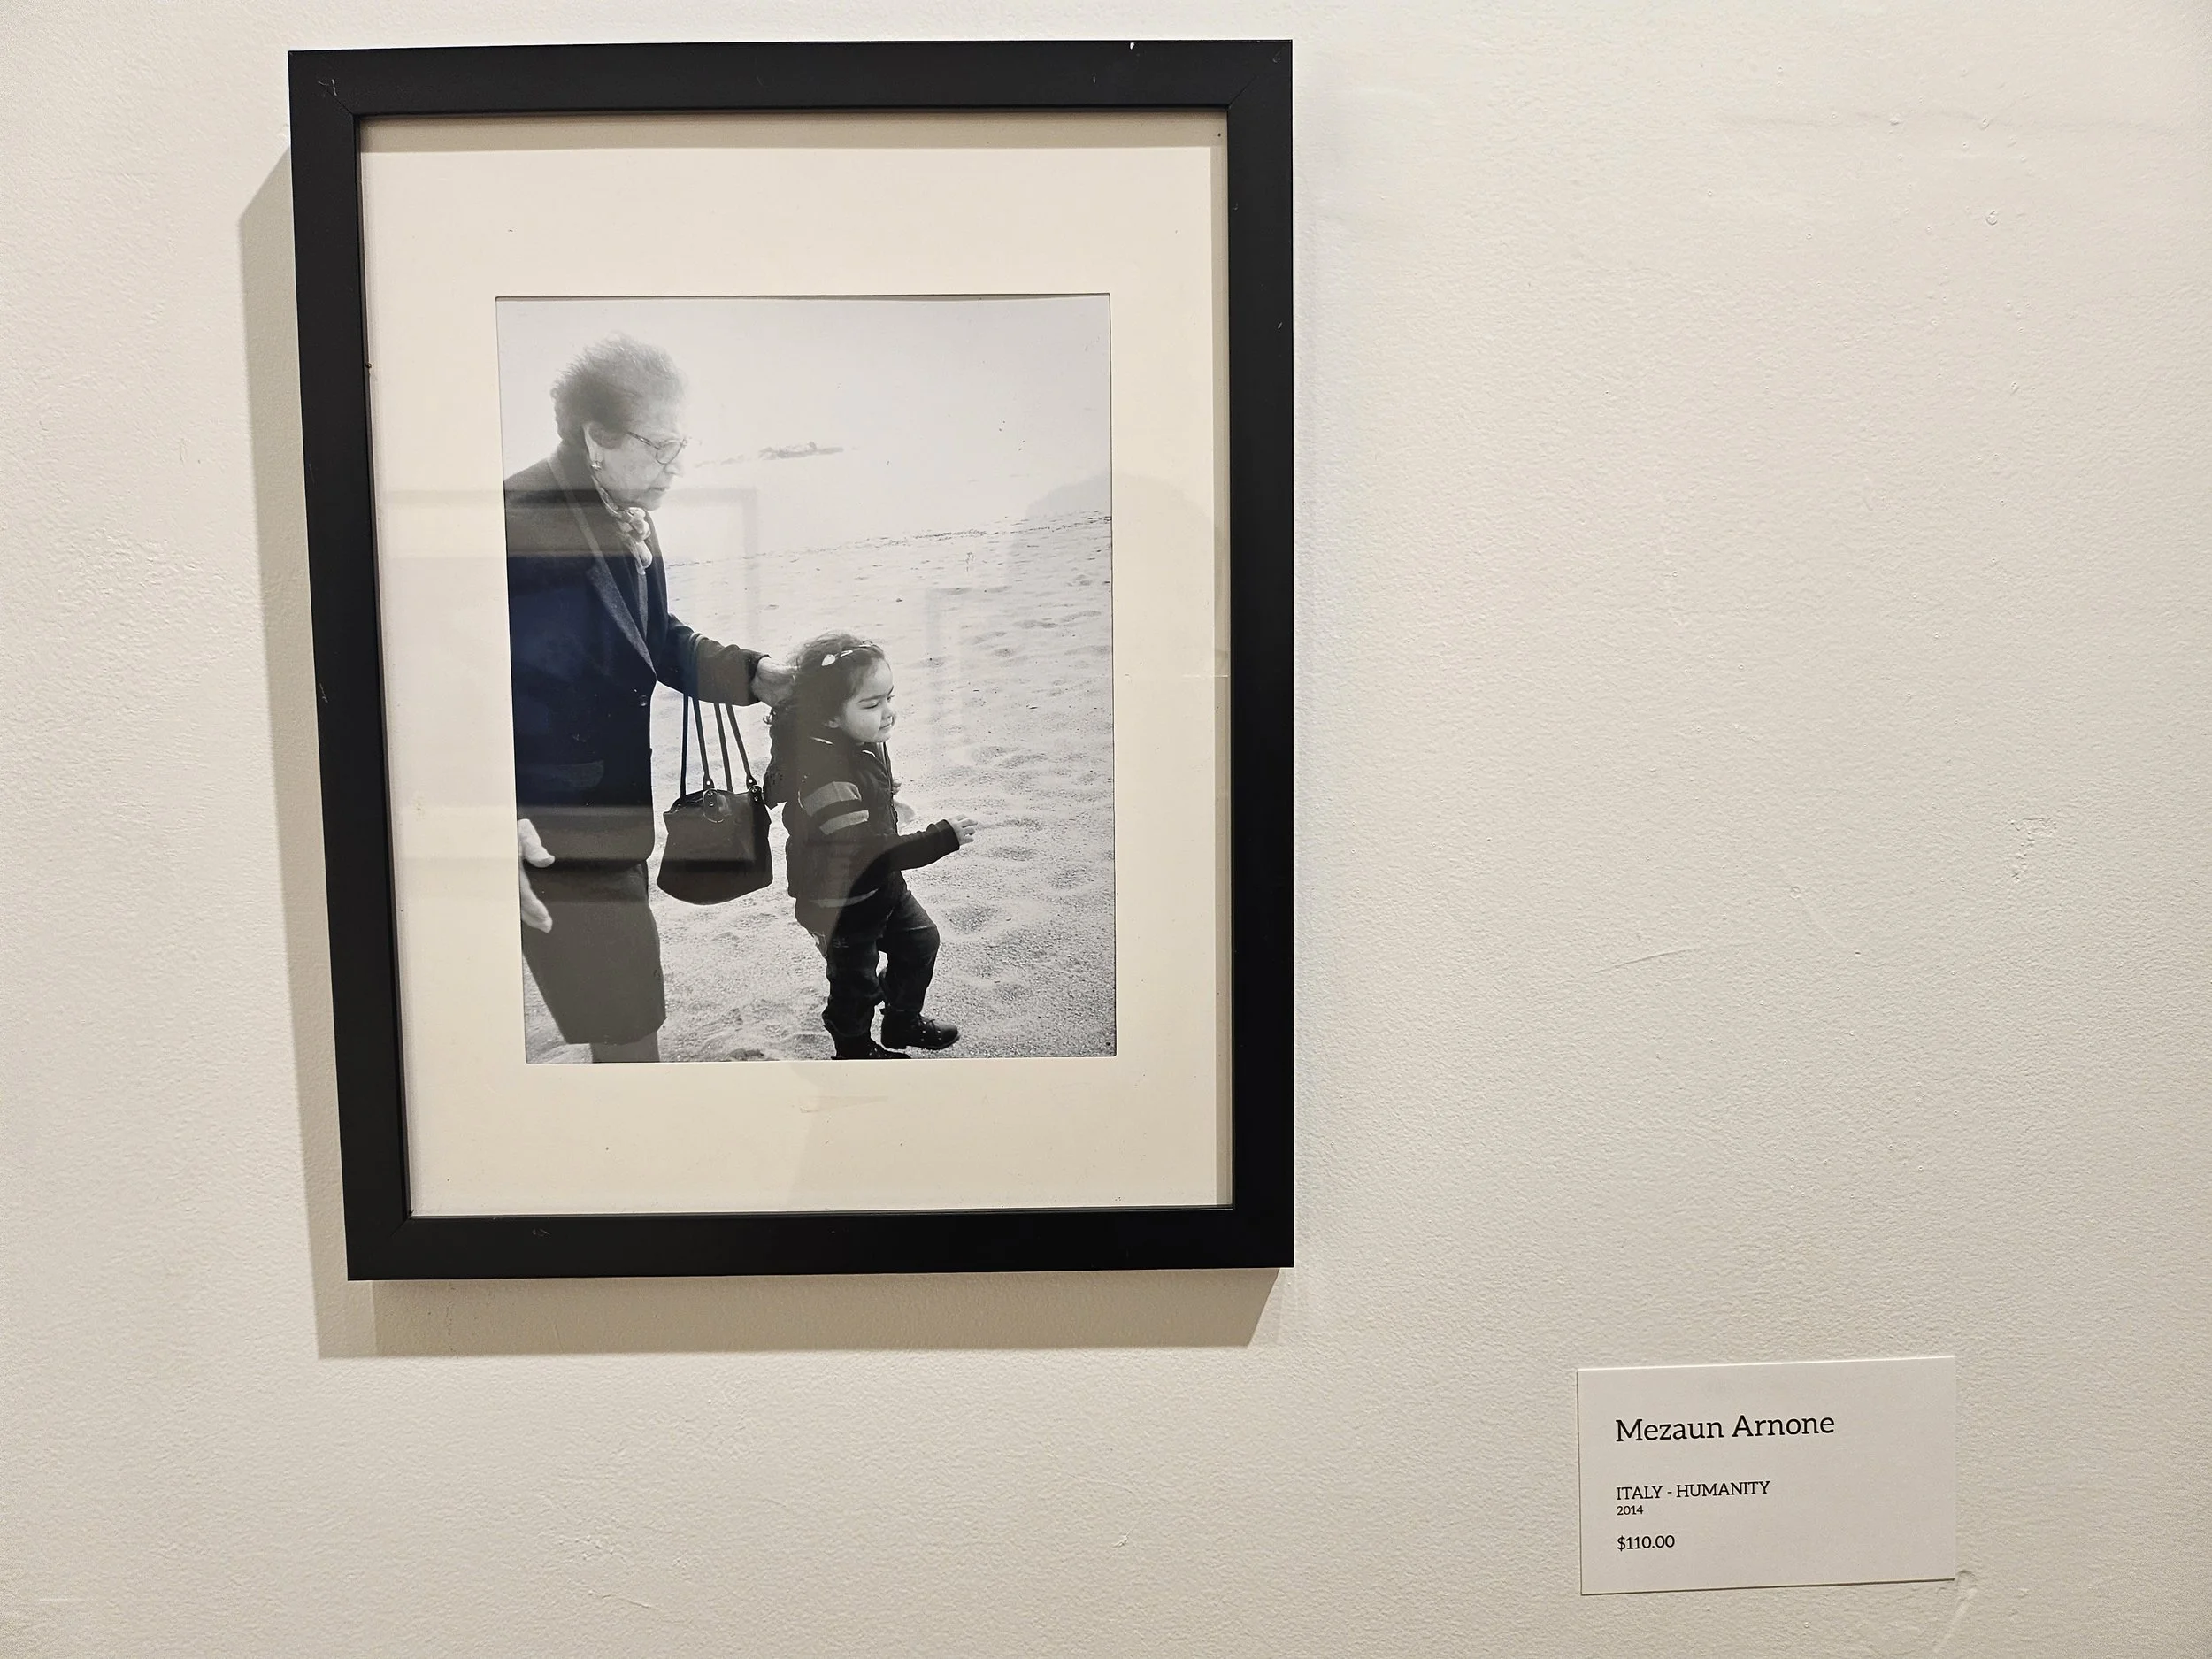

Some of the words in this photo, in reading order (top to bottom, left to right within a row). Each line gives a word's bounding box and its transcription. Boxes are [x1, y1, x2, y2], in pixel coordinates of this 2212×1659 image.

[1615, 1418, 1724, 1442] Mezaun
[1731, 1415, 1835, 1438] Arnone
[1616, 1486, 1663, 1501] ITALY
[1676, 1480, 1771, 1498] HUMANITY
[1617, 1504, 1645, 1516] 2014
[1617, 1534, 1676, 1552] $110.00
